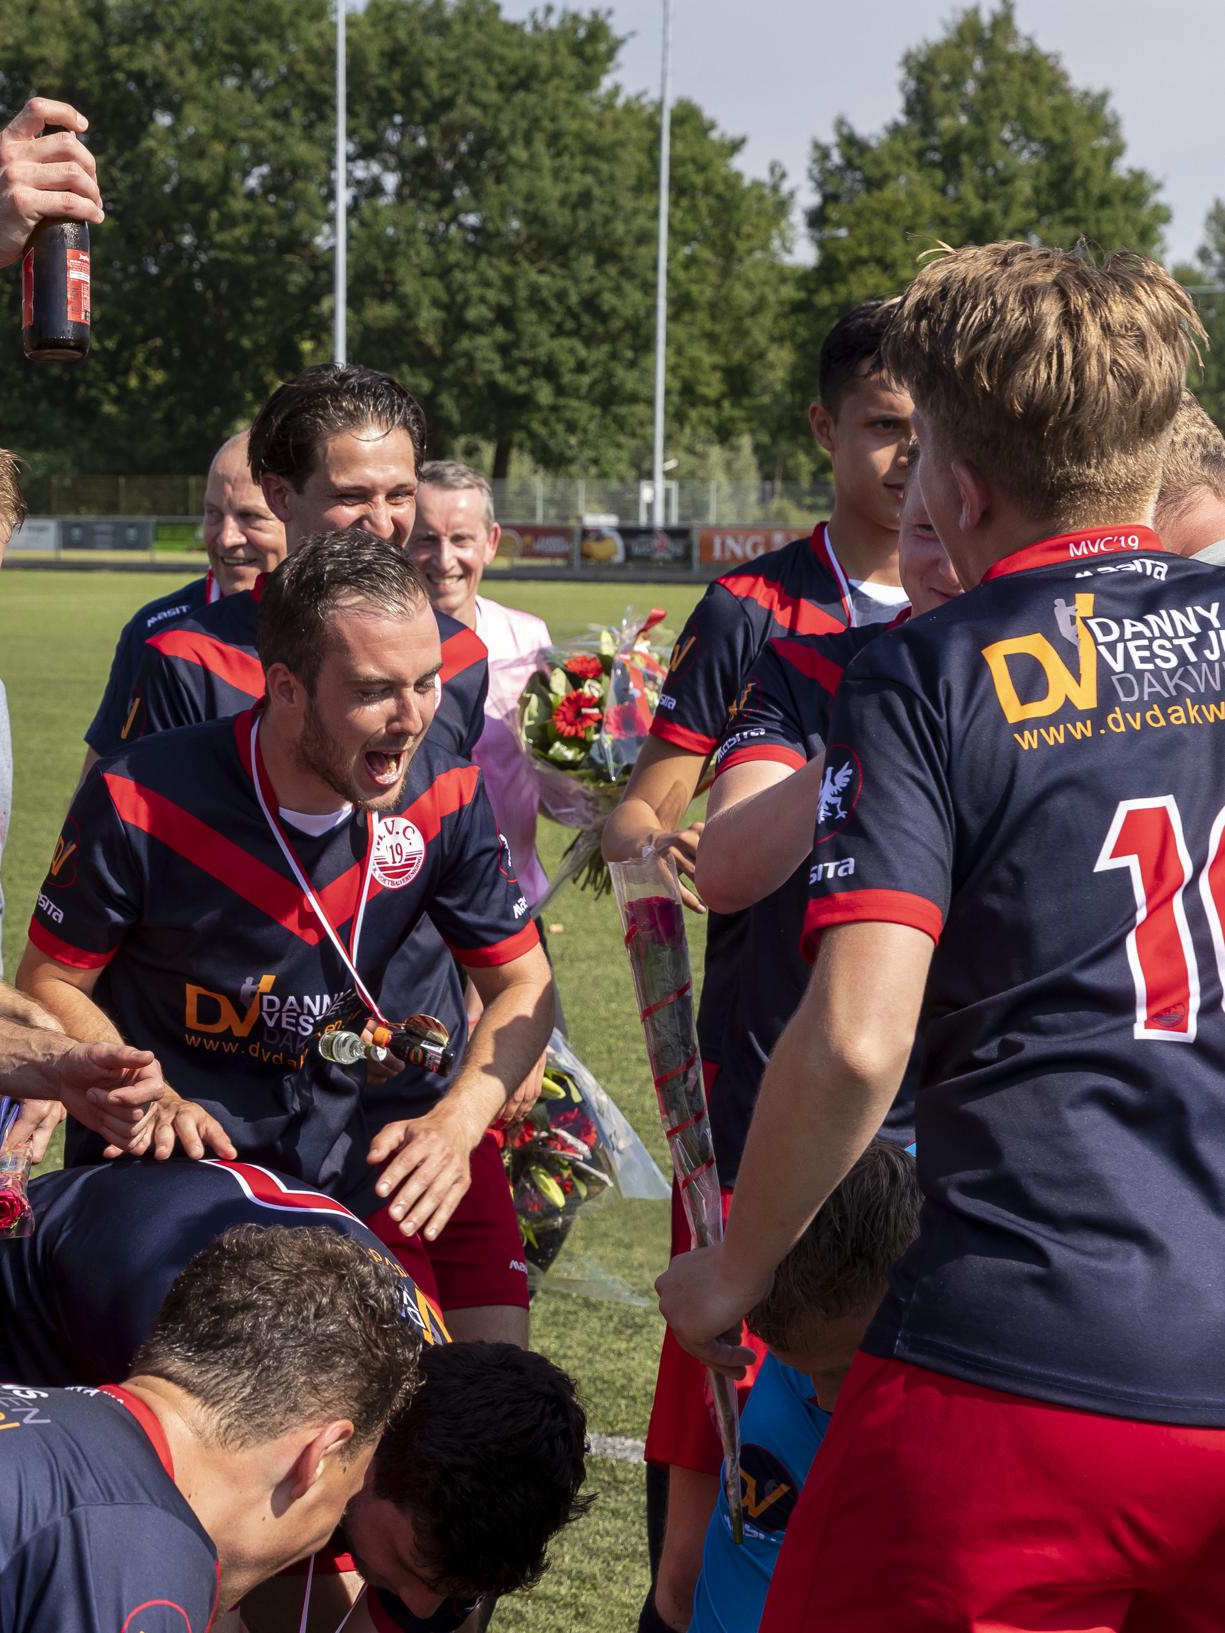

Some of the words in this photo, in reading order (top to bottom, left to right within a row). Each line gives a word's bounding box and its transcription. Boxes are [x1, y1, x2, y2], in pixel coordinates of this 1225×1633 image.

[712, 534, 765, 560] ING
[1069, 535, 1140, 558] MVC'19
[1086, 602, 1222, 643] DANNY
[1111, 661, 1225, 702] DAKW
[185, 974, 276, 1037] DV
